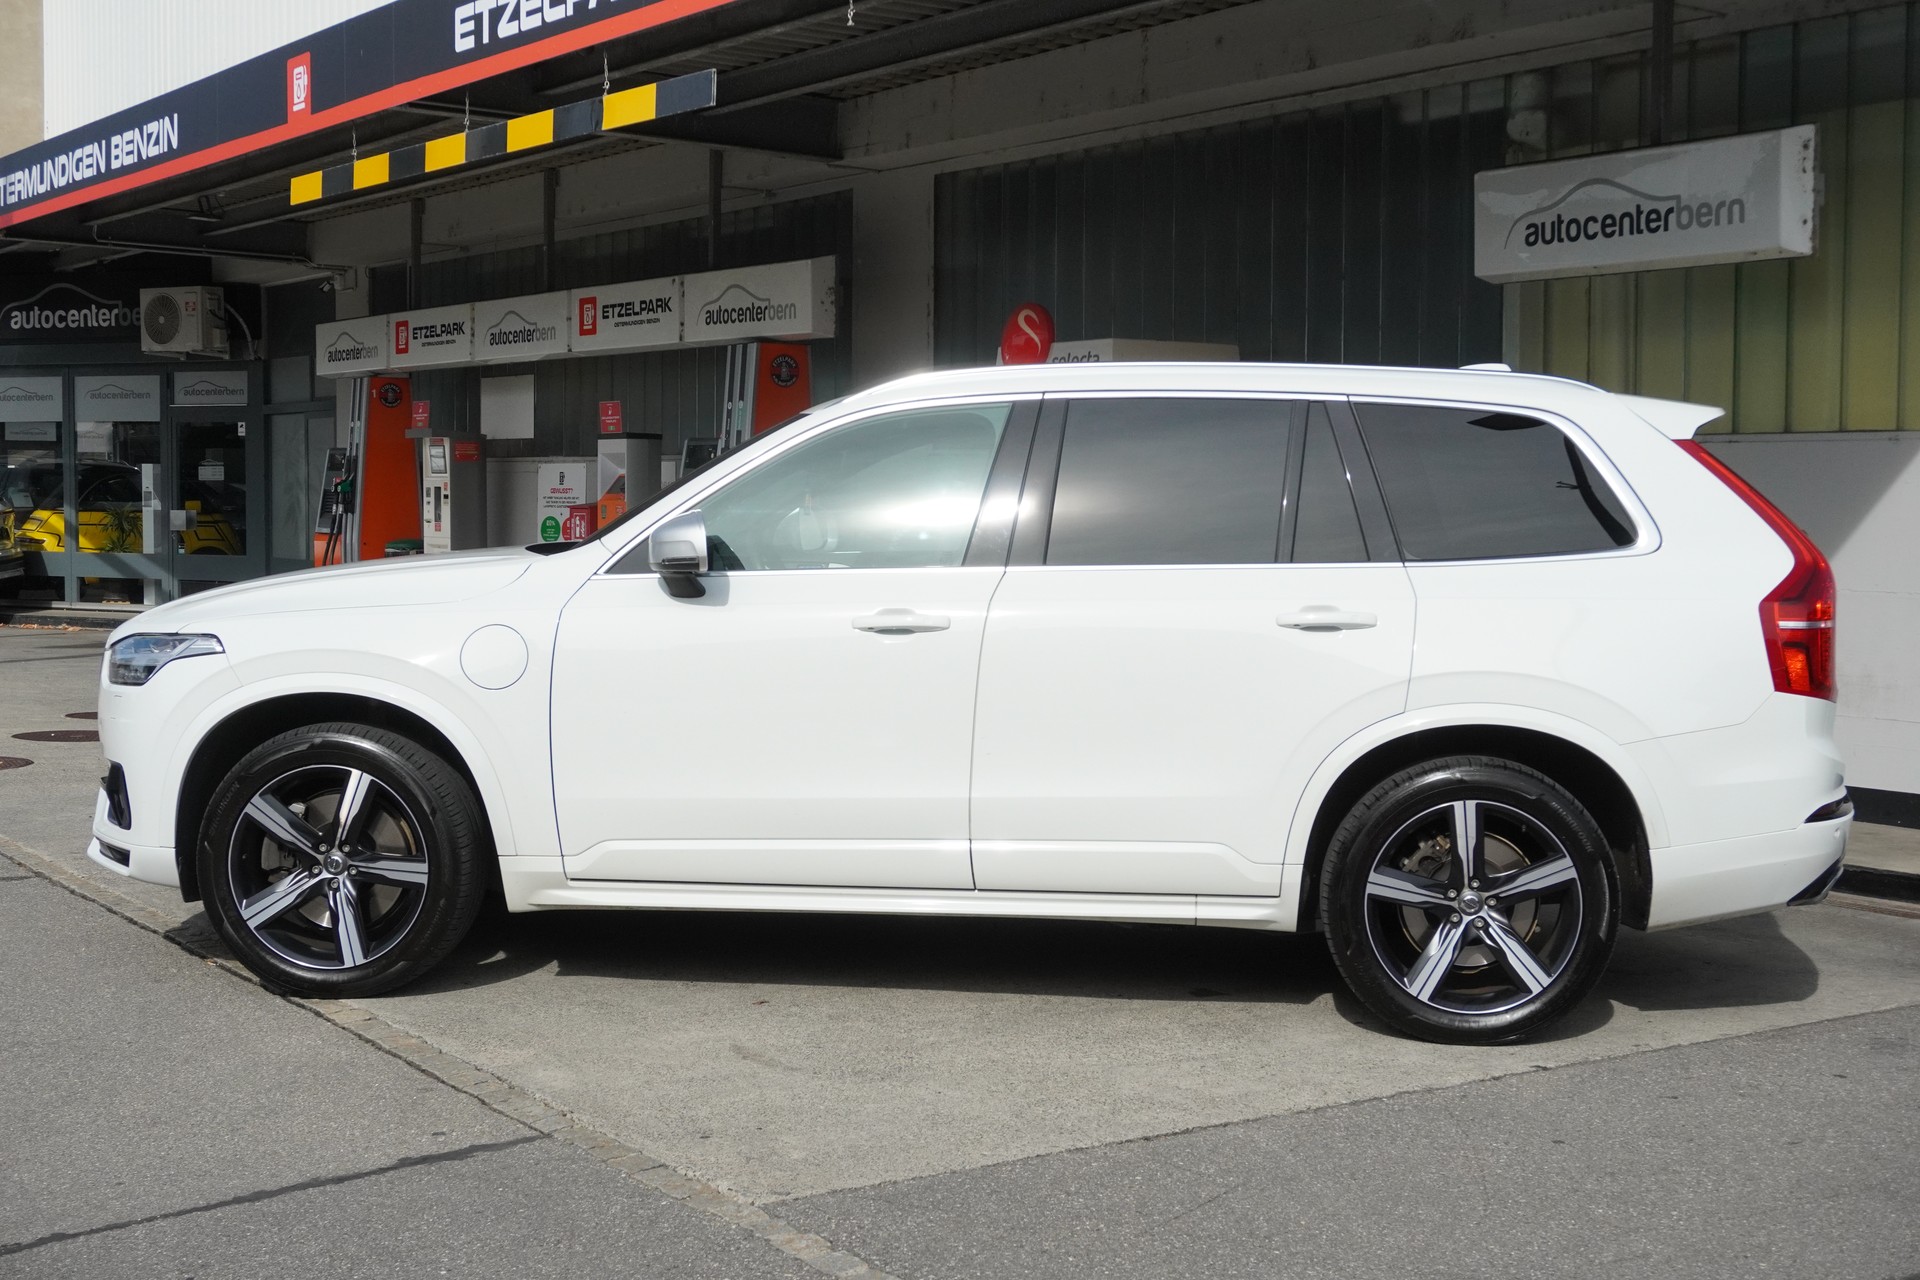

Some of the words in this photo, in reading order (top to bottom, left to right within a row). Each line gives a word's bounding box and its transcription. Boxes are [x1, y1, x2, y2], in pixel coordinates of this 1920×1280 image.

[455, 0, 618, 53] ETZEL
[111, 113, 179, 170] BENZIN
[1525, 197, 1746, 248] autocenterbern
[11, 304, 141, 329] autocenterbe
[602, 297, 673, 320] ETZELPARK
[705, 302, 797, 326] autocenterbern
[412, 322, 466, 340] ETZELPARK
[490, 324, 556, 347] autocenterbern
[328, 343, 379, 363] autocenterbern
[89, 389, 151, 400] autocenterbern
[183, 386, 245, 397] autocenterbern
